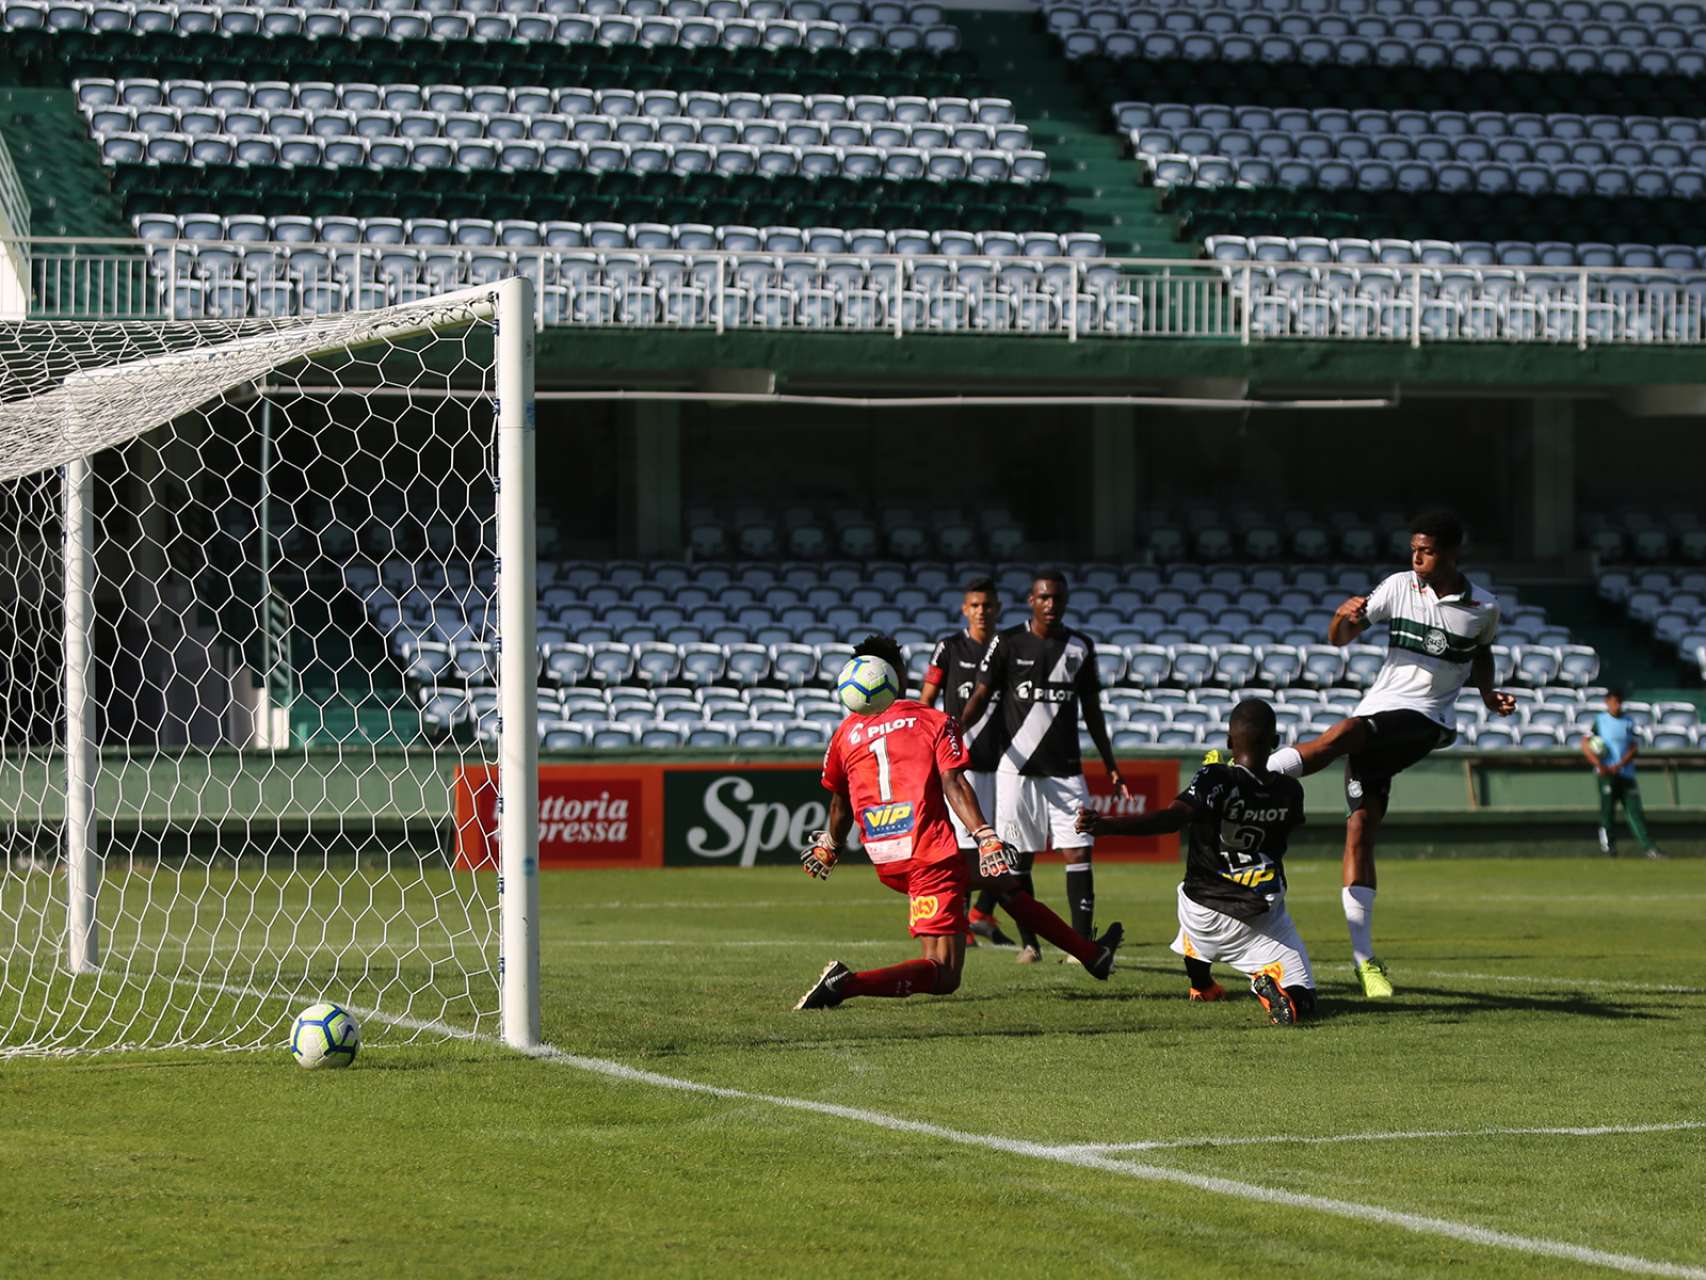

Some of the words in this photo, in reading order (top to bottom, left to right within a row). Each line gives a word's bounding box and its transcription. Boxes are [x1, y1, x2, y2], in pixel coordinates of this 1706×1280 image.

[1033, 687, 1074, 701] PILOT
[867, 717, 917, 738] PILOT
[868, 735, 892, 802] 1
[1243, 808, 1288, 822] PILOT
